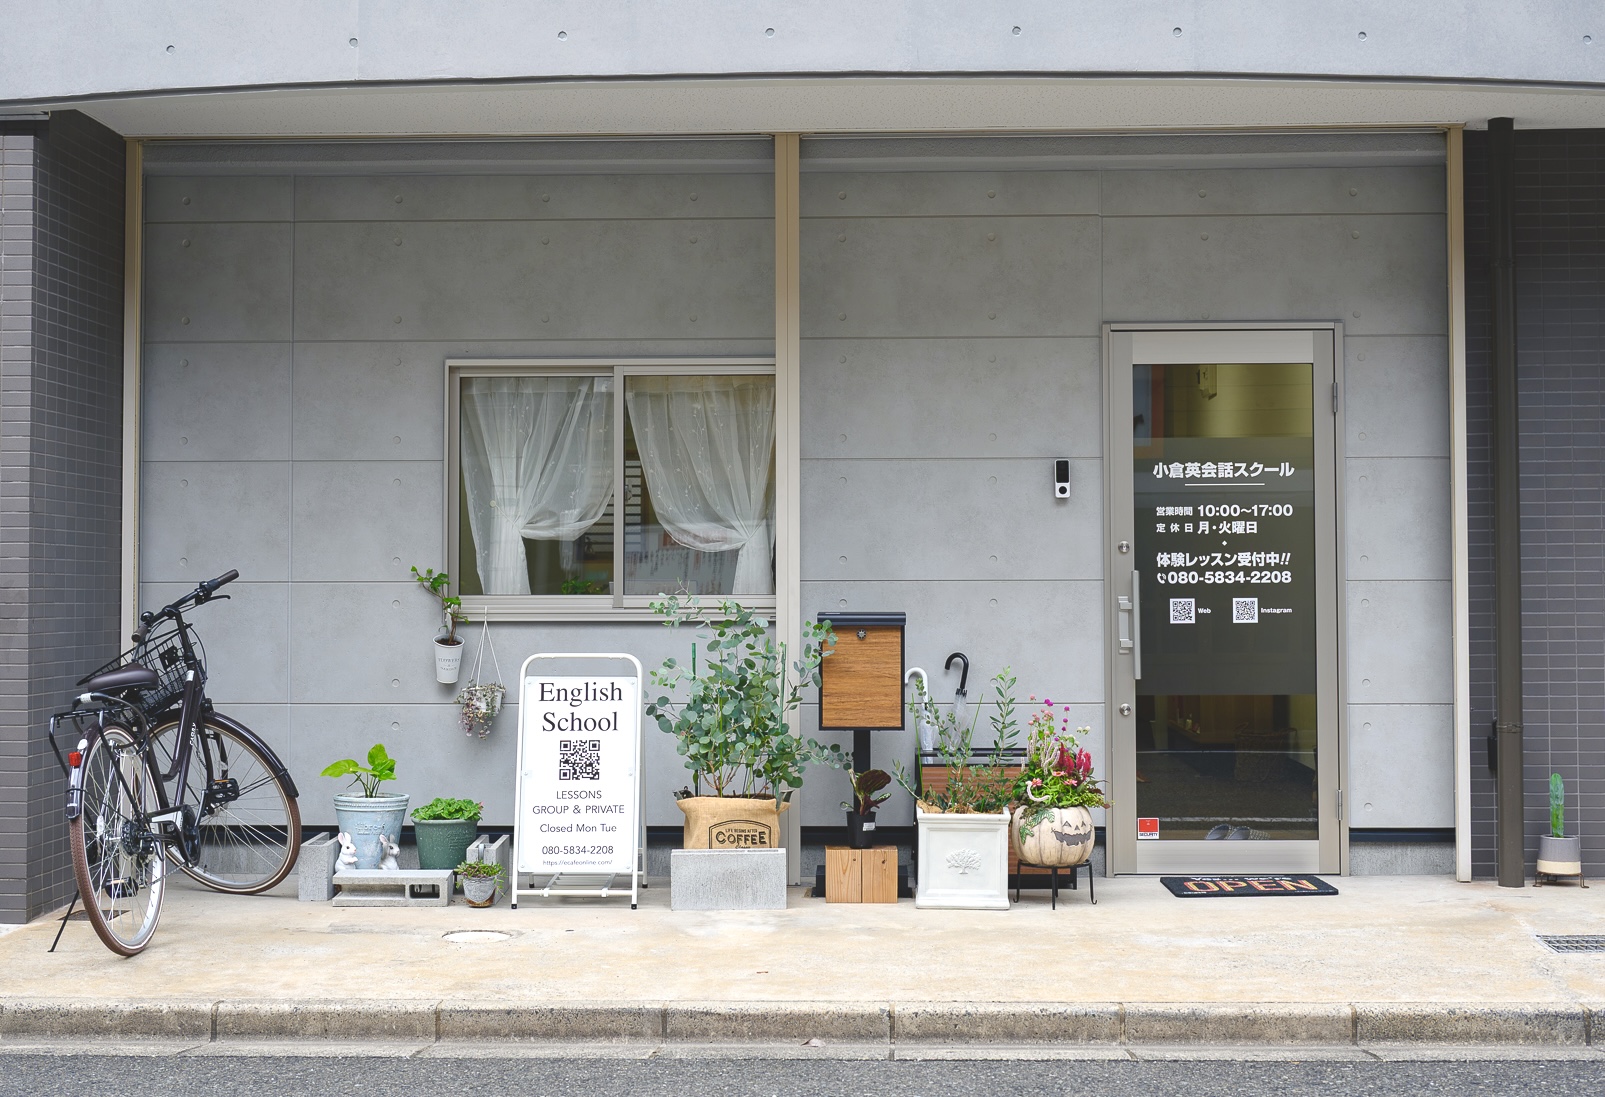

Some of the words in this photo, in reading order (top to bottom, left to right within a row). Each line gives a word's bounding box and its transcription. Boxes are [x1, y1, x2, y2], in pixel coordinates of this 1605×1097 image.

[1152, 461, 1295, 479] 小倉英会話スクール
[1156, 506, 1193, 516] 営業時間
[1156, 552, 1291, 567] 体験レッスン受付中!!
[1167, 571, 1292, 584] 080-5834-2208
[1260, 607, 1293, 615] Instagram
[538, 681, 623, 707] English
[542, 711, 618, 732] School
[556, 790, 602, 800] LESSONS
[532, 805, 569, 814] GROUP
[572, 804, 581, 814] &
[585, 804, 625, 814] PRIVATE
[539, 823, 573, 833] Closed
[575, 823, 597, 833] Mon
[599, 823, 617, 832] Tue
[716, 831, 767, 845] COFFEE
[541, 845, 614, 855] 080-5834-2208
[542, 859, 613, 867] https://ecafeonline.com/
[1183, 879, 1319, 892] OPEN
